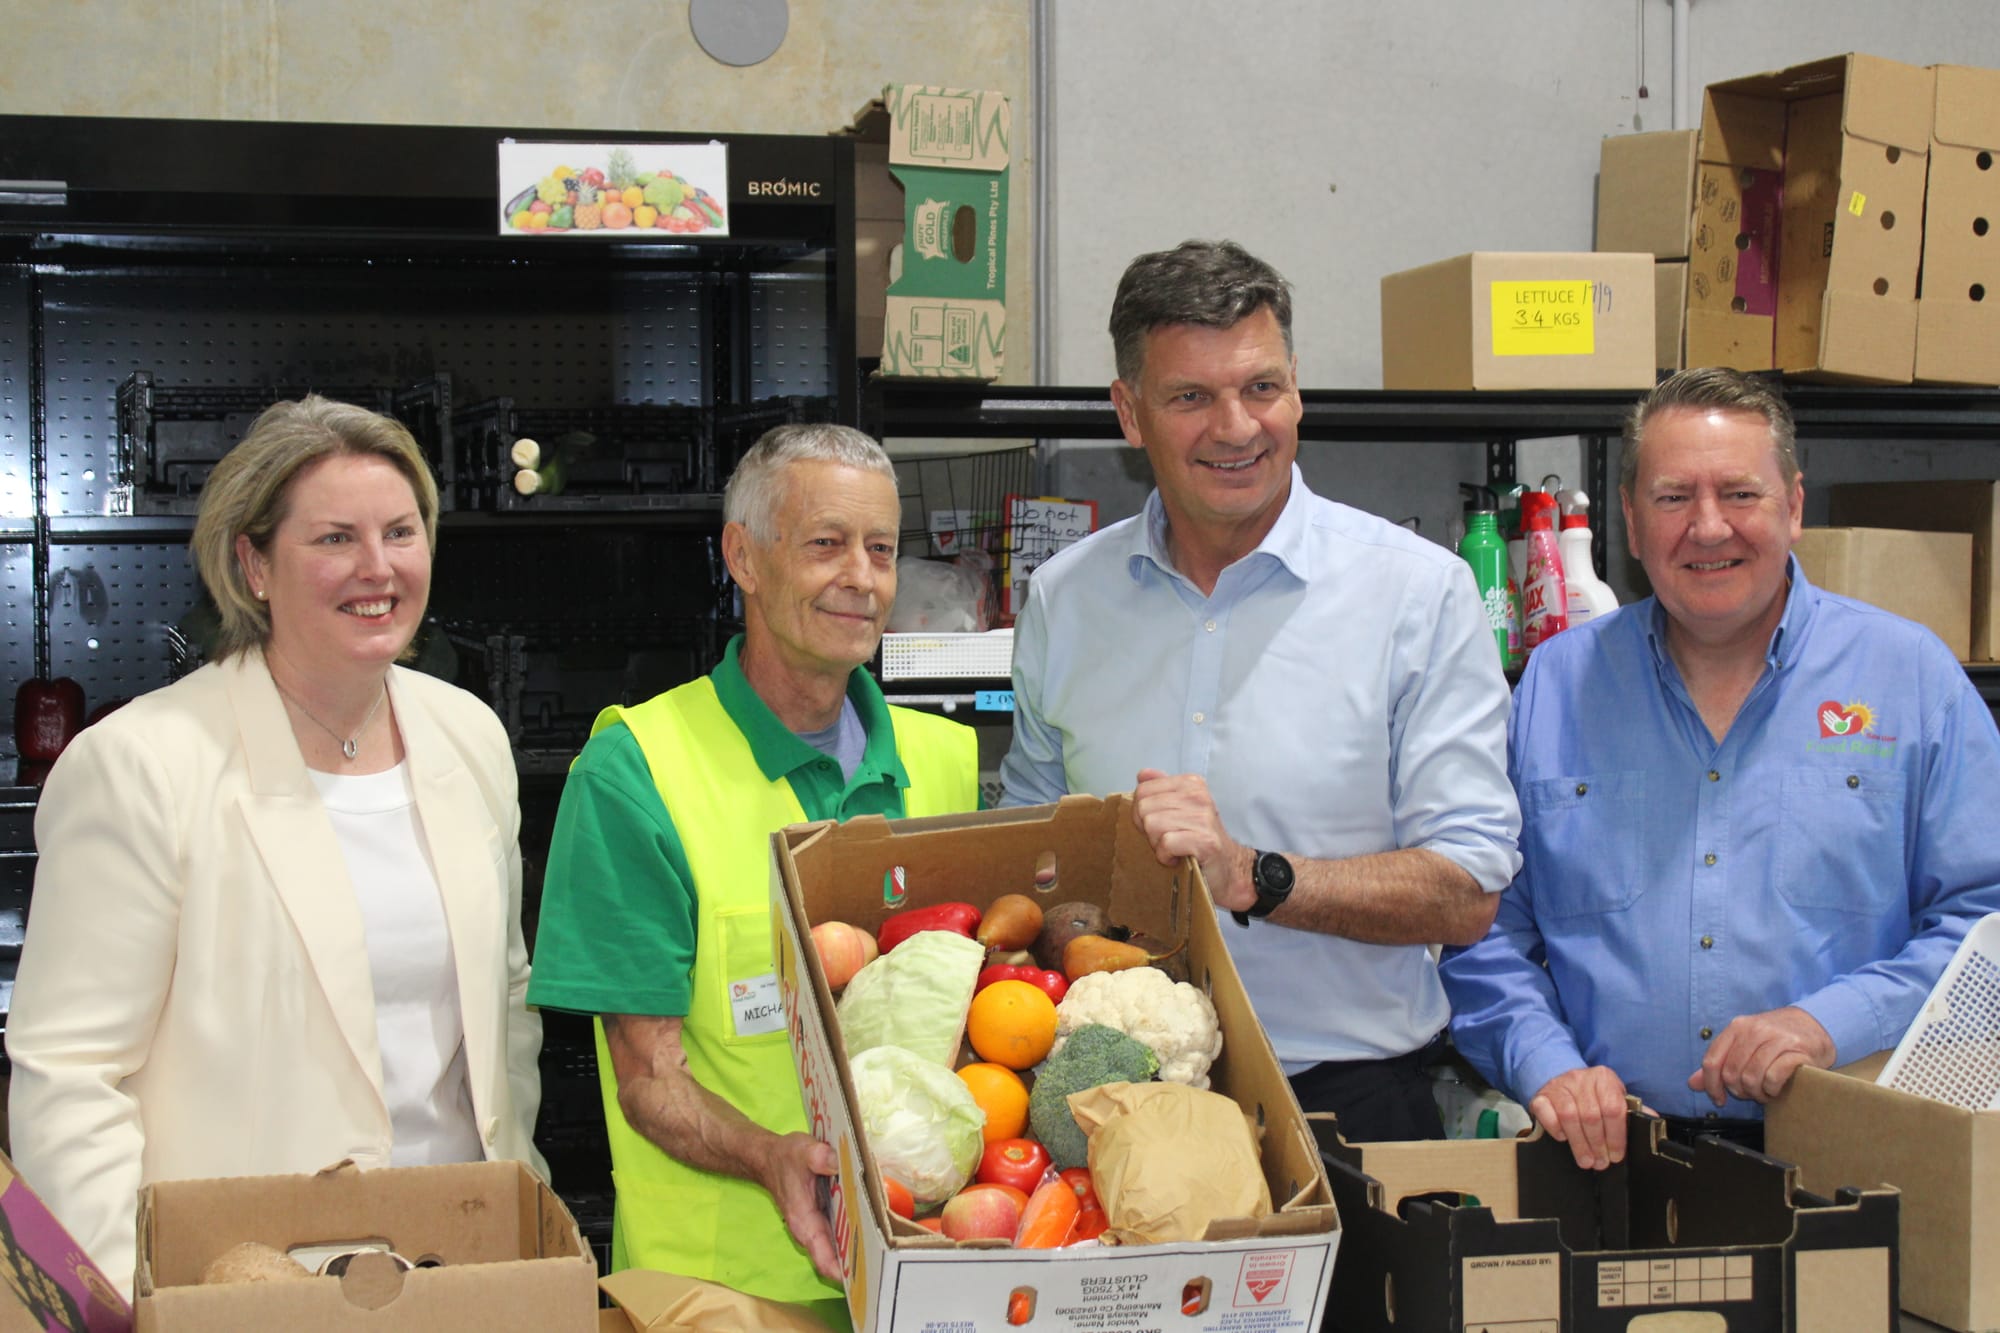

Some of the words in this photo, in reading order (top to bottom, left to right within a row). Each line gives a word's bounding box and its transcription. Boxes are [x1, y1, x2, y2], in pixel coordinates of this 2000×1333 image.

[990, 180, 999, 198] Ltd
[989, 200, 1000, 217] Pty
[924, 212, 936, 244] GOLD
[988, 218, 998, 246] Pines
[986, 248, 997, 290] Tropical
[1515, 290, 1575, 304] LETTUCE
[1553, 312, 1580, 326] KGS
[1045, 506, 1079, 523] not
[984, 694, 992, 705] 2
[1470, 1261, 1499, 1269] GROWN
[1506, 1258, 1538, 1266] PACKED
[1080, 1274, 1148, 1286] CLUSTERS
[1082, 1286, 1113, 1295] 750G
[1122, 1292, 1138, 1300] Net
[1082, 1294, 1120, 1303] Content
[1116, 1302, 1162, 1312] Marketing
[1068, 1314, 1104, 1322] Banana
[1107, 1310, 1148, 1320] Mackays
[1107, 1319, 1140, 1327] Vendor
